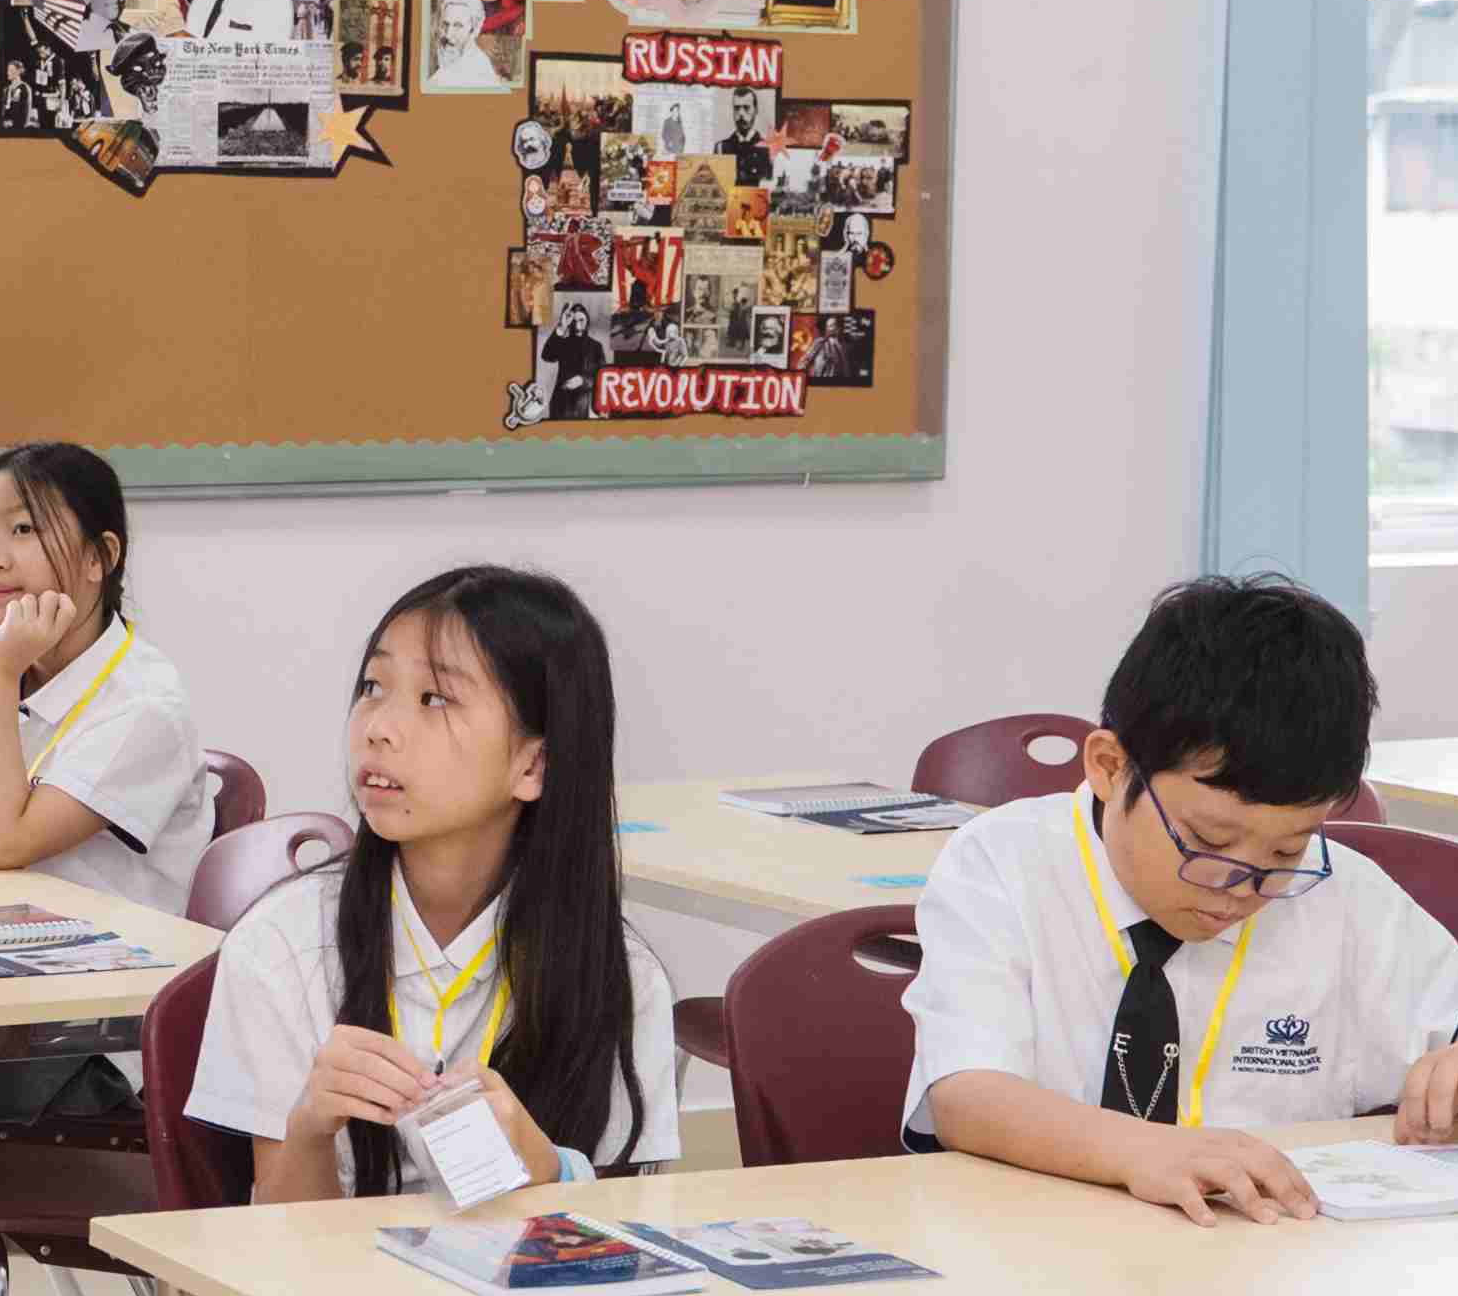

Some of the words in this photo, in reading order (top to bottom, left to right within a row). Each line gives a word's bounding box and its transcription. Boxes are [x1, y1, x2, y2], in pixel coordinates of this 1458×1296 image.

[182, 40, 205, 55] The
[207, 42, 233, 56] New
[235, 43, 260, 57] York
[626, 38, 782, 82] RUSSIAN
[1241, 1046, 1273, 1056] BRITISH
[1232, 1056, 1296, 1067] INTERNATIONAL
